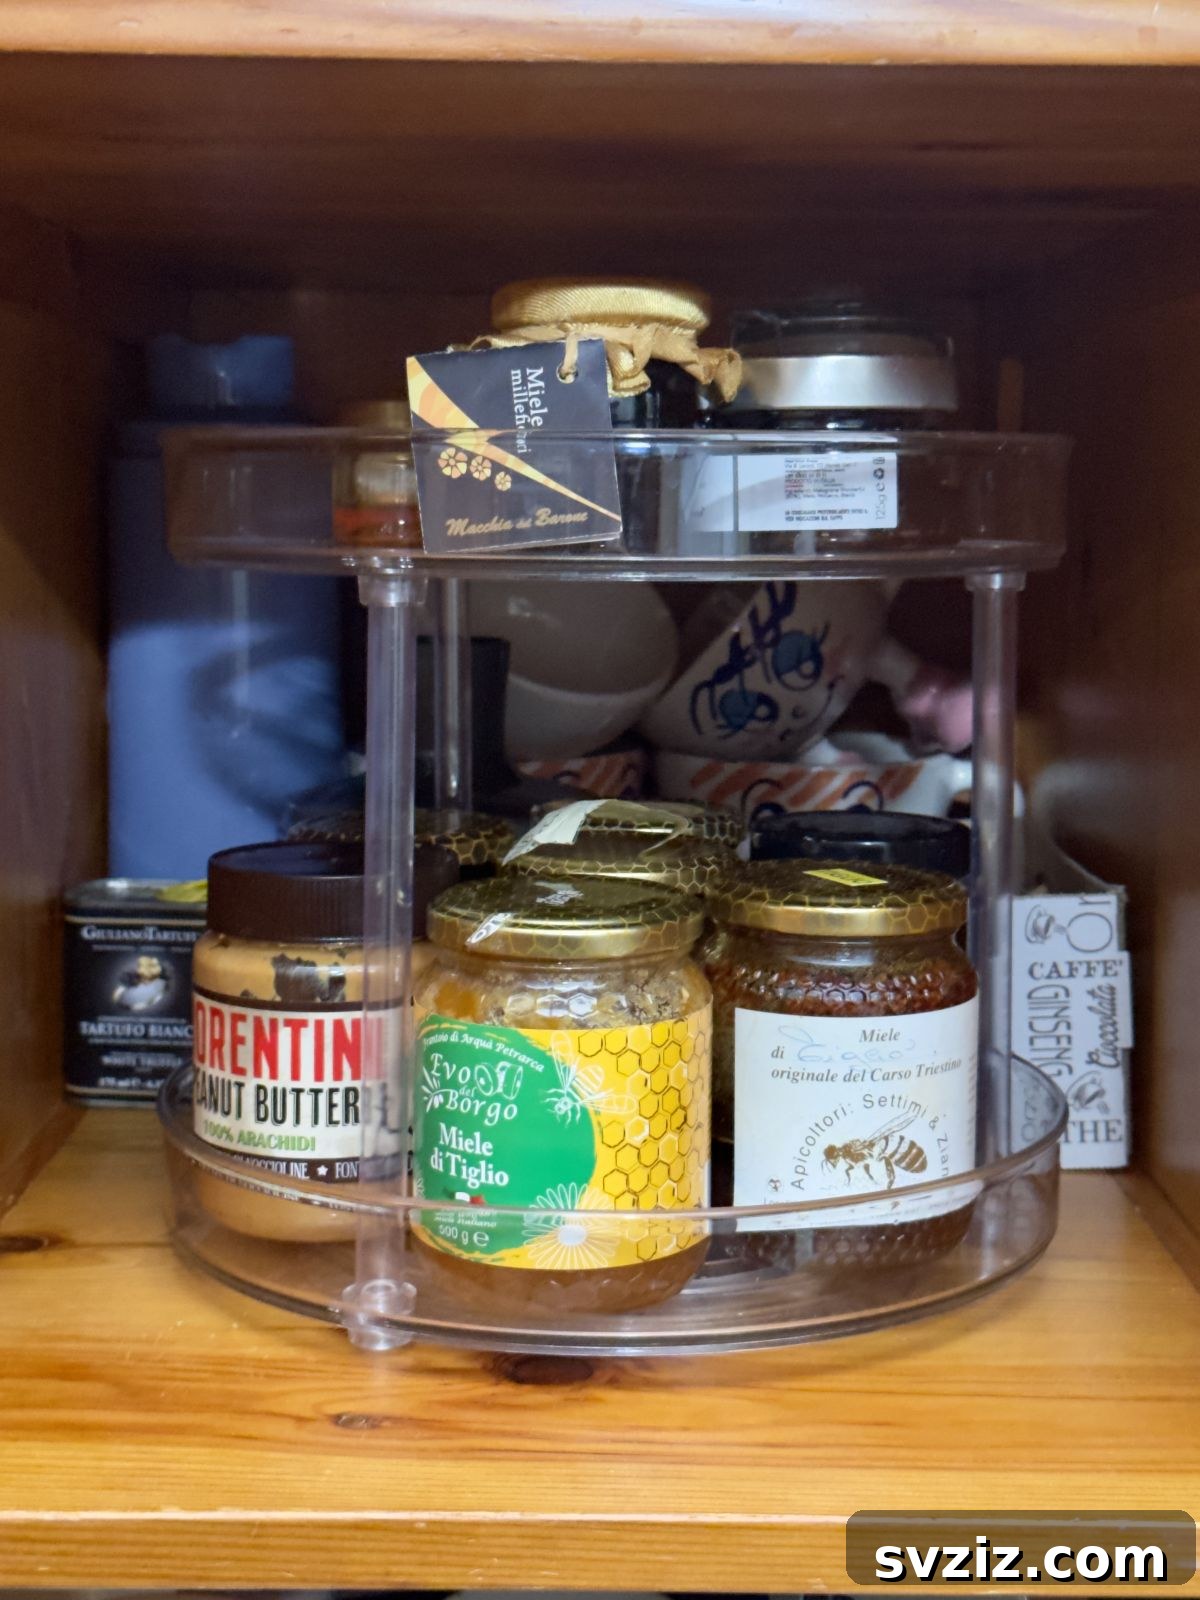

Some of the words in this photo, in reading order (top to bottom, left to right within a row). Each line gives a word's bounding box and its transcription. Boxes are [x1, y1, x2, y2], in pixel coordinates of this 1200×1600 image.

[526, 366, 549, 427] Miele
[1028, 959, 1124, 981] CAFFE'
[148, 1023, 194, 1039] BIANC
[194, 1001, 383, 1082] ORENTIN
[859, 1028, 901, 1042] Miele
[1027, 983, 1073, 1078] GINSENG
[430, 1052, 471, 1085] Evo
[449, 1030, 459, 1043] di
[495, 1042, 545, 1073] Petrarca
[771, 1046, 785, 1059] di
[771, 1068, 838, 1084] originale
[843, 1068, 866, 1083] del
[870, 1067, 912, 1082] Carso
[915, 1058, 962, 1078] Triestino
[254, 1083, 361, 1127] BUTTER
[446, 1088, 518, 1127] Borgo
[202, 1119, 234, 1143] 100%
[237, 1131, 316, 1152] ARACHIDI
[439, 1122, 493, 1157] Miele
[790, 1100, 854, 1191] Apicoltori:
[928, 1115, 941, 1131] &
[936, 1132, 949, 1177] Zian
[334, 1160, 361, 1179] FON
[430, 1147, 444, 1172] di
[444, 1152, 510, 1189] Tiglio
[438, 1224, 459, 1240] 500
[461, 1230, 469, 1246] g
